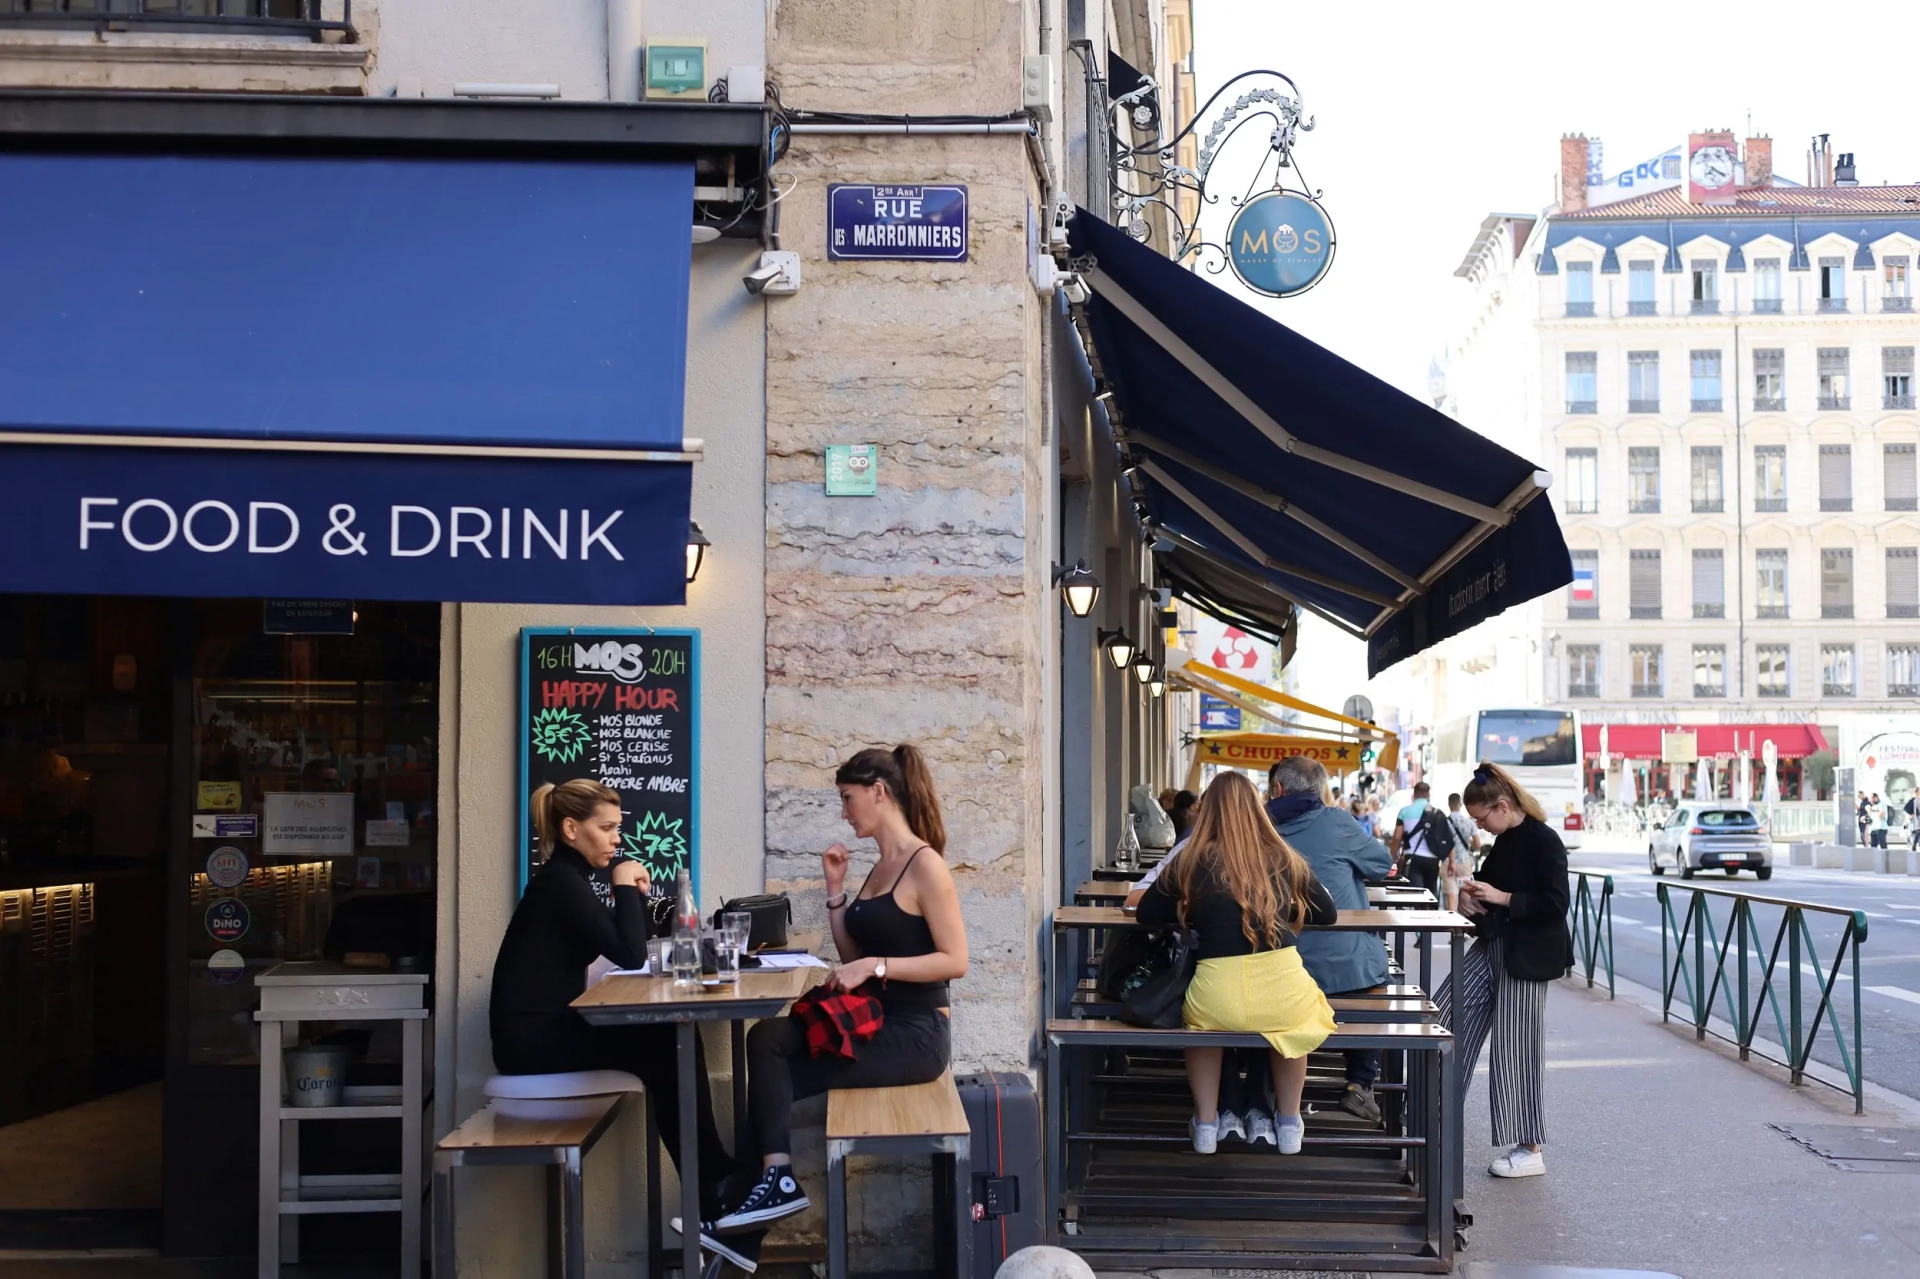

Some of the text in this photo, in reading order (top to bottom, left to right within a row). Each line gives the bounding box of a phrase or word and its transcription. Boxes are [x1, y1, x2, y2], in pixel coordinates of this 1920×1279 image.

[874, 200, 923, 218] RUE
[834, 224, 962, 248] DES MARRONNIERS
[1240, 228, 1322, 254] MOS
[830, 453, 842, 482] 2019
[79, 496, 625, 561] FOOD & DRINK
[537, 641, 686, 679] 16H MOS 20H
[541, 680, 680, 712] HAPPY HOUR
[600, 714, 663, 727] MOS BLONDE
[544, 724, 573, 745] 5€
[599, 728, 672, 740] MOS BLANCHE
[600, 739, 623, 752] MOS
[1226, 743, 1331, 760] CHURROS
[1879, 745, 1920, 753] FESTIVAL
[617, 752, 673, 766] Stefanus
[599, 763, 632, 776] Asahi
[647, 775, 689, 793] AMBRE
[642, 833, 675, 858] 7€
[213, 918, 242, 929] DiNO
[297, 1076, 341, 1093] Coron
